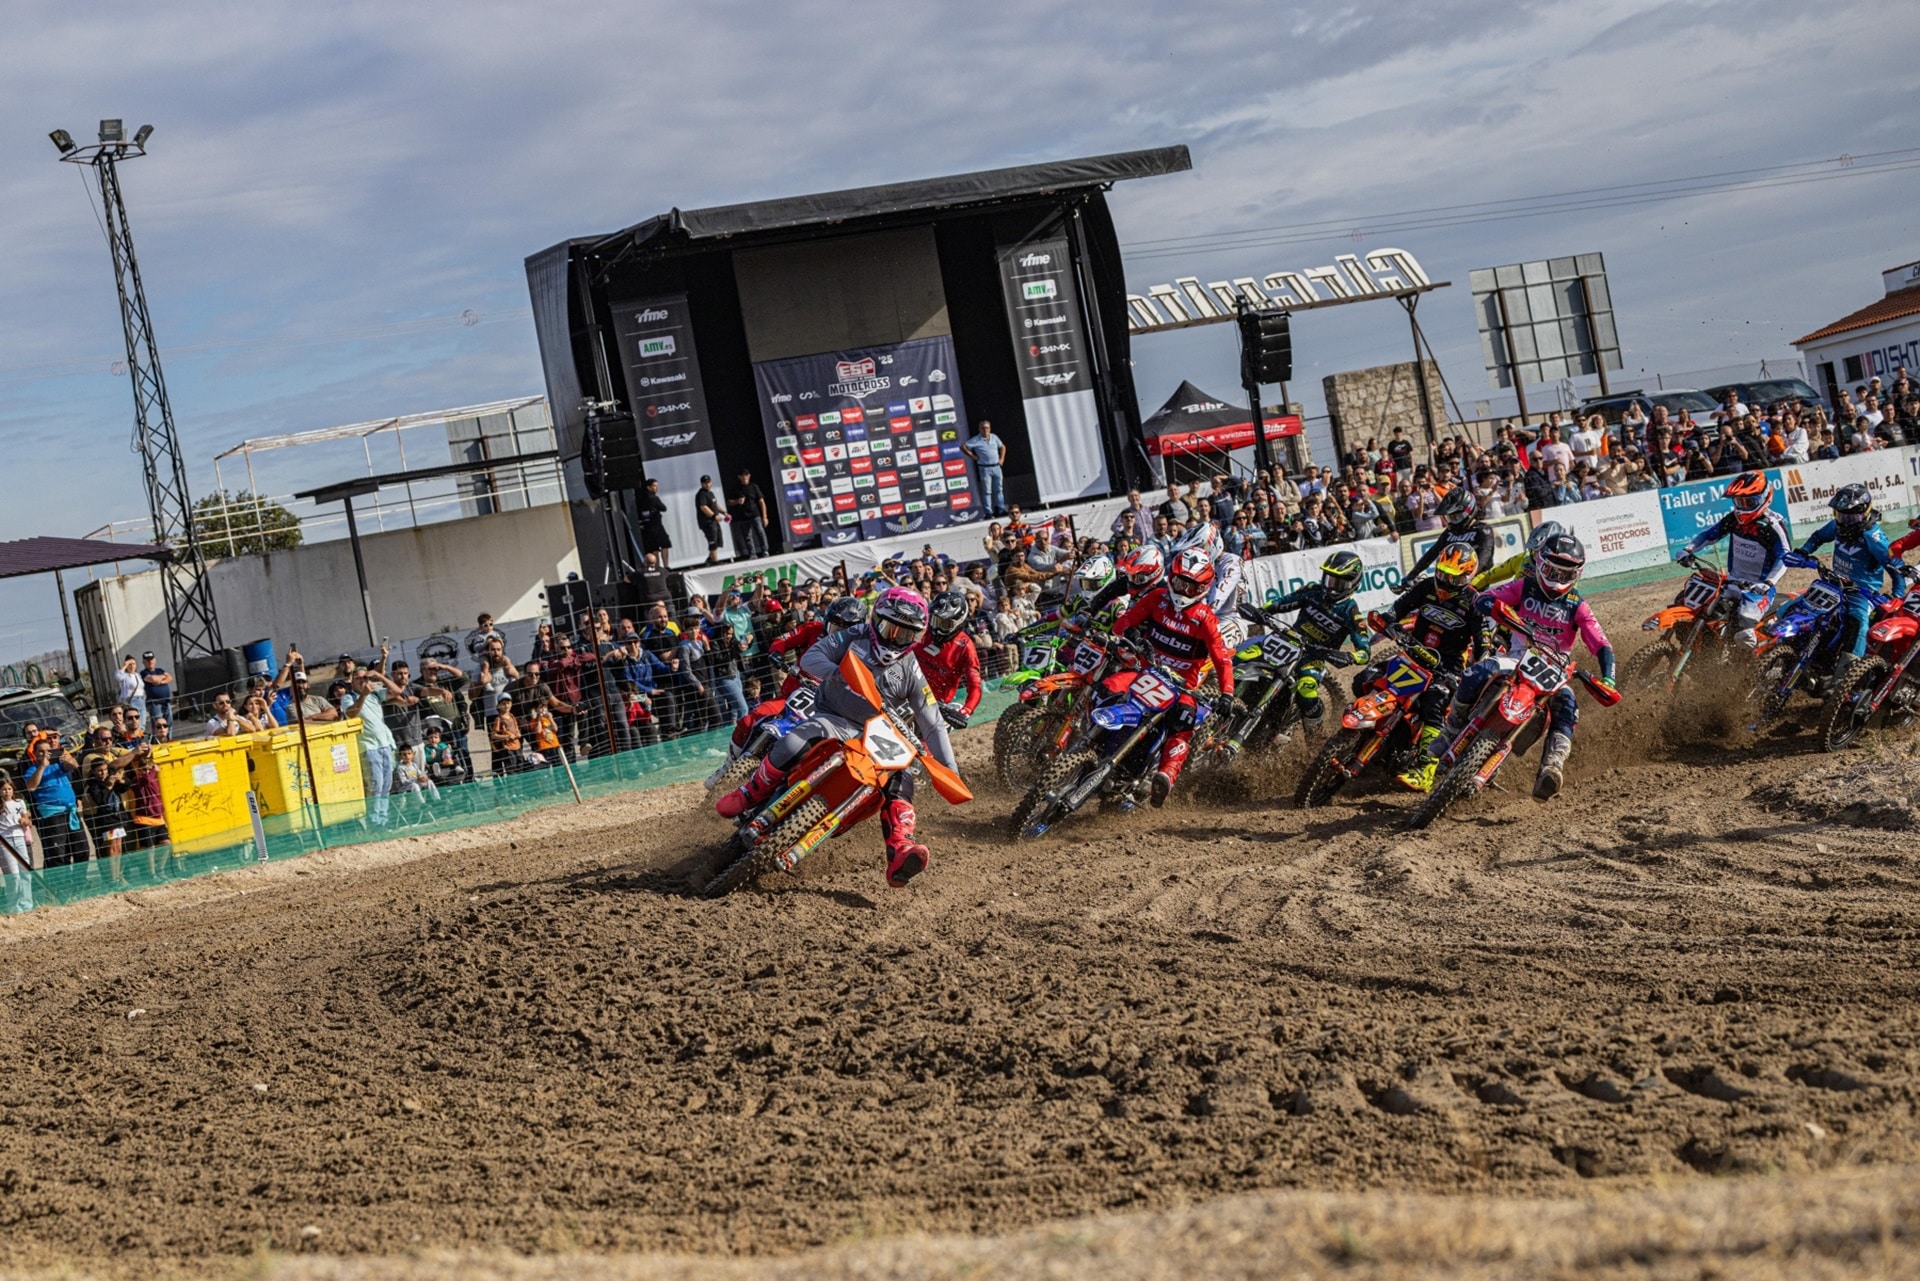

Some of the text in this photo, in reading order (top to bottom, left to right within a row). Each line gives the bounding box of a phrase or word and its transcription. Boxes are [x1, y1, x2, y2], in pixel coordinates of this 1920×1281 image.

[637, 309, 668, 323] rfme
[651, 372, 687, 384] Kawasaki
[829, 378, 889, 395] MOTOCROSS
[1182, 402, 1225, 413] Bihr
[1661, 490, 1706, 510] Taller
[1600, 528, 1650, 543] MOTOCROSS
[1601, 541, 1625, 553] ELITE
[1363, 560, 1398, 571] Extremadura
[1686, 581, 1713, 605] 111
[1162, 616, 1190, 634] YAMAHA
[1151, 628, 1192, 652] hebo
[1027, 647, 1050, 664] 5
[1079, 645, 1100, 667] 25
[1264, 640, 1297, 661] 501
[1387, 663, 1424, 688] 17
[1520, 656, 1560, 690] 96
[1130, 674, 1174, 707] 92
[869, 734, 907, 761] 4
